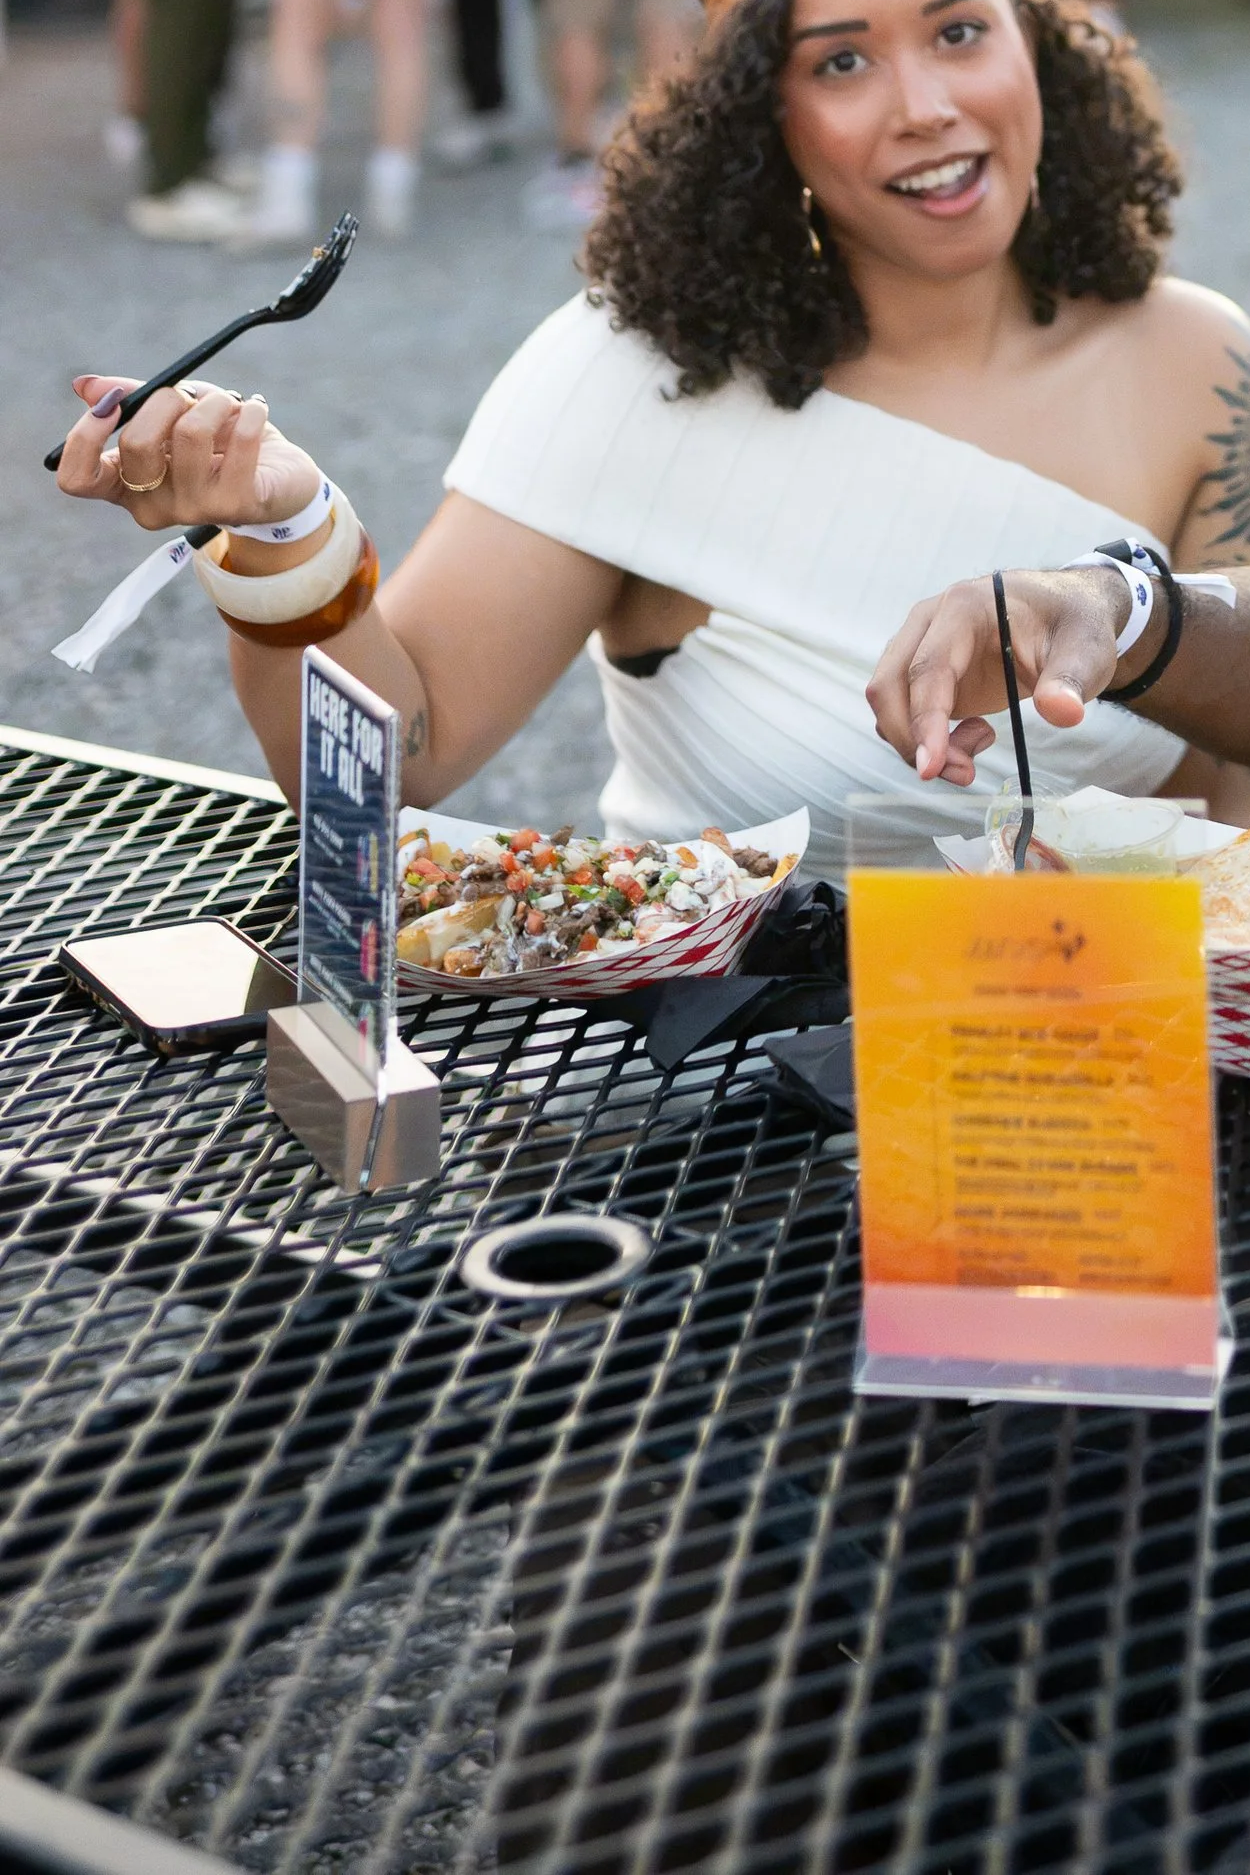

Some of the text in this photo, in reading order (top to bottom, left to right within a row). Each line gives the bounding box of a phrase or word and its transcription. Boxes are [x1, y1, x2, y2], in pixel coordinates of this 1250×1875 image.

[309, 672, 384, 776] HERE FOR
[320, 728, 365, 807] IT ALL
